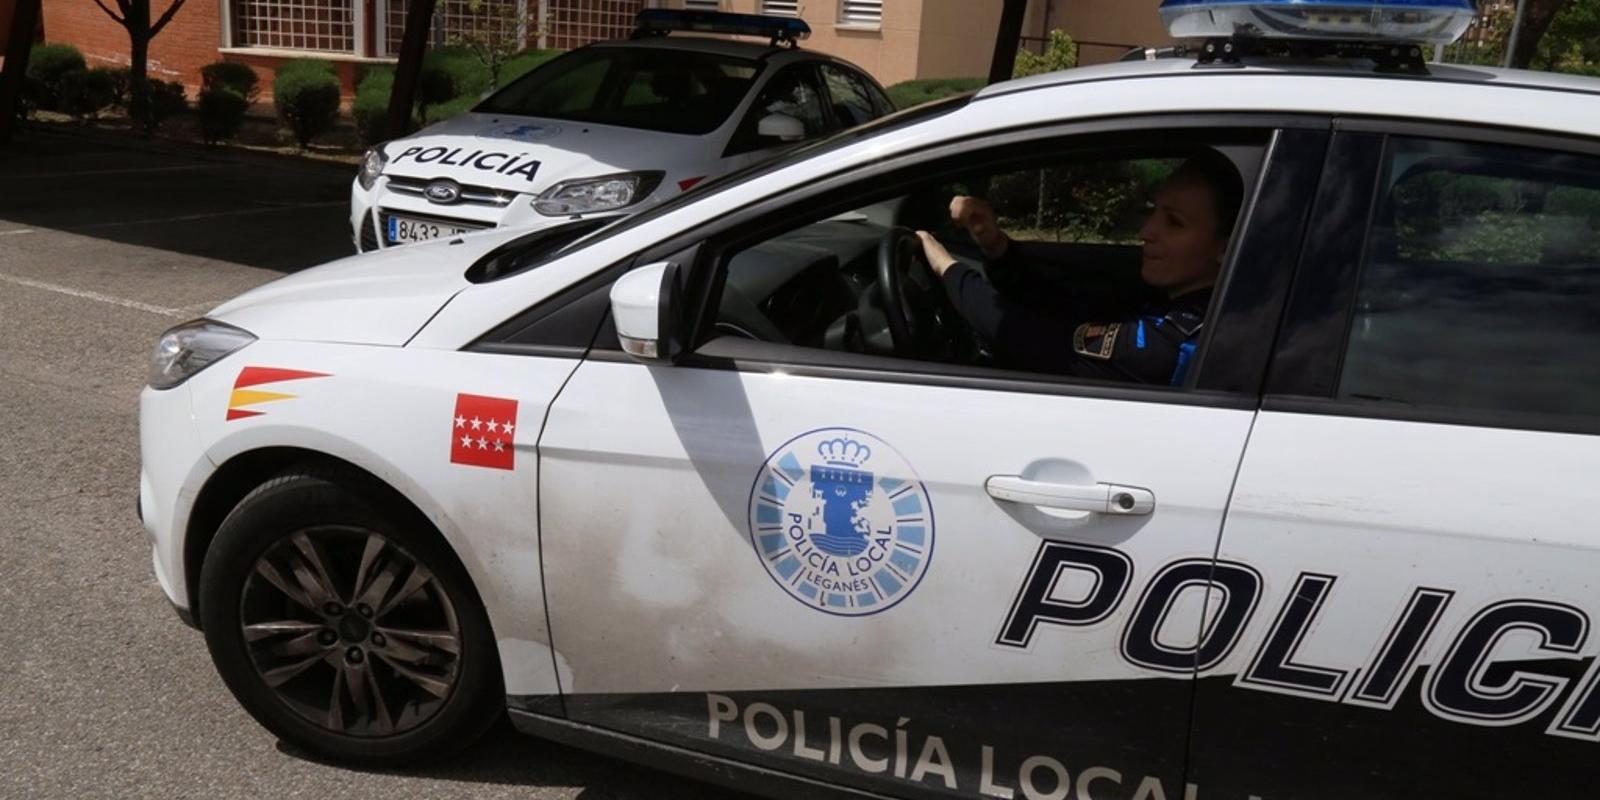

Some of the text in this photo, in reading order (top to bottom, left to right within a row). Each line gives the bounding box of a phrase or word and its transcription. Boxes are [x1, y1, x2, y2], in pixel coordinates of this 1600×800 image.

[392, 146, 542, 182] POLICÍA
[788, 512, 892, 576] POLICÍA LOCAL
[806, 570, 869, 592] LEGANÉS
[705, 692, 958, 790] POLICÍA
